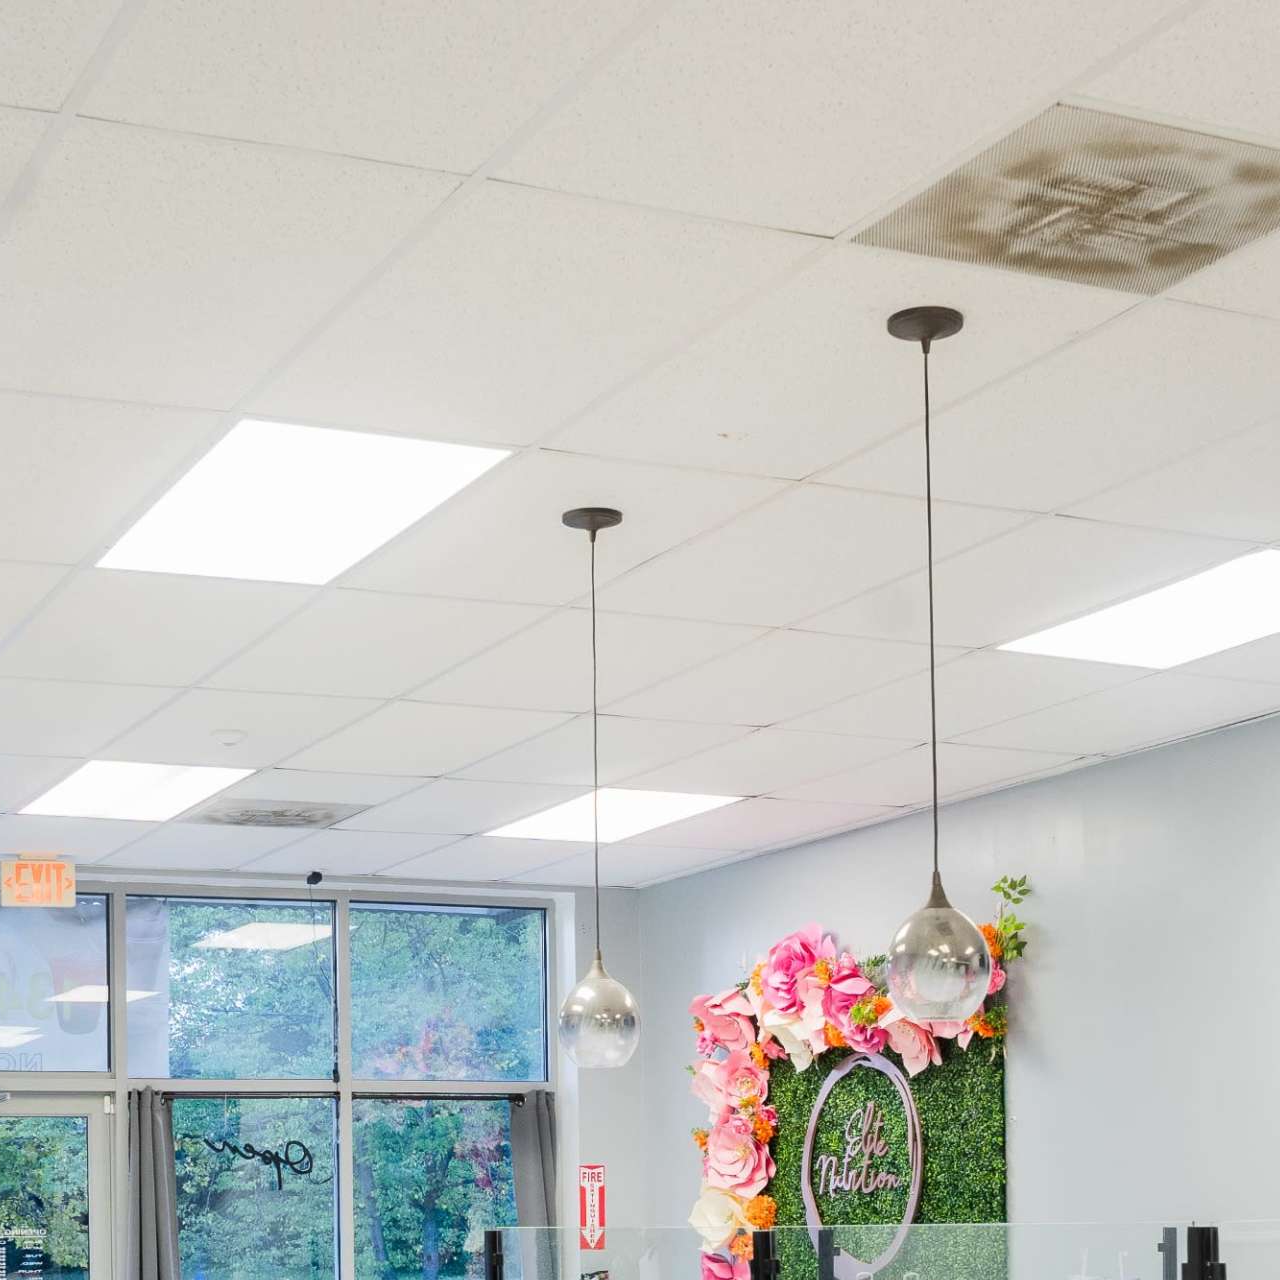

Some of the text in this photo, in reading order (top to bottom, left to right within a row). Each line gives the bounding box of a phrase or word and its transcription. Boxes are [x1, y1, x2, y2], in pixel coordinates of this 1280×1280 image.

[15, 863, 66, 903] EXIT
[845, 1101, 889, 1157] Elite
[581, 1171, 603, 1183] FIRE
